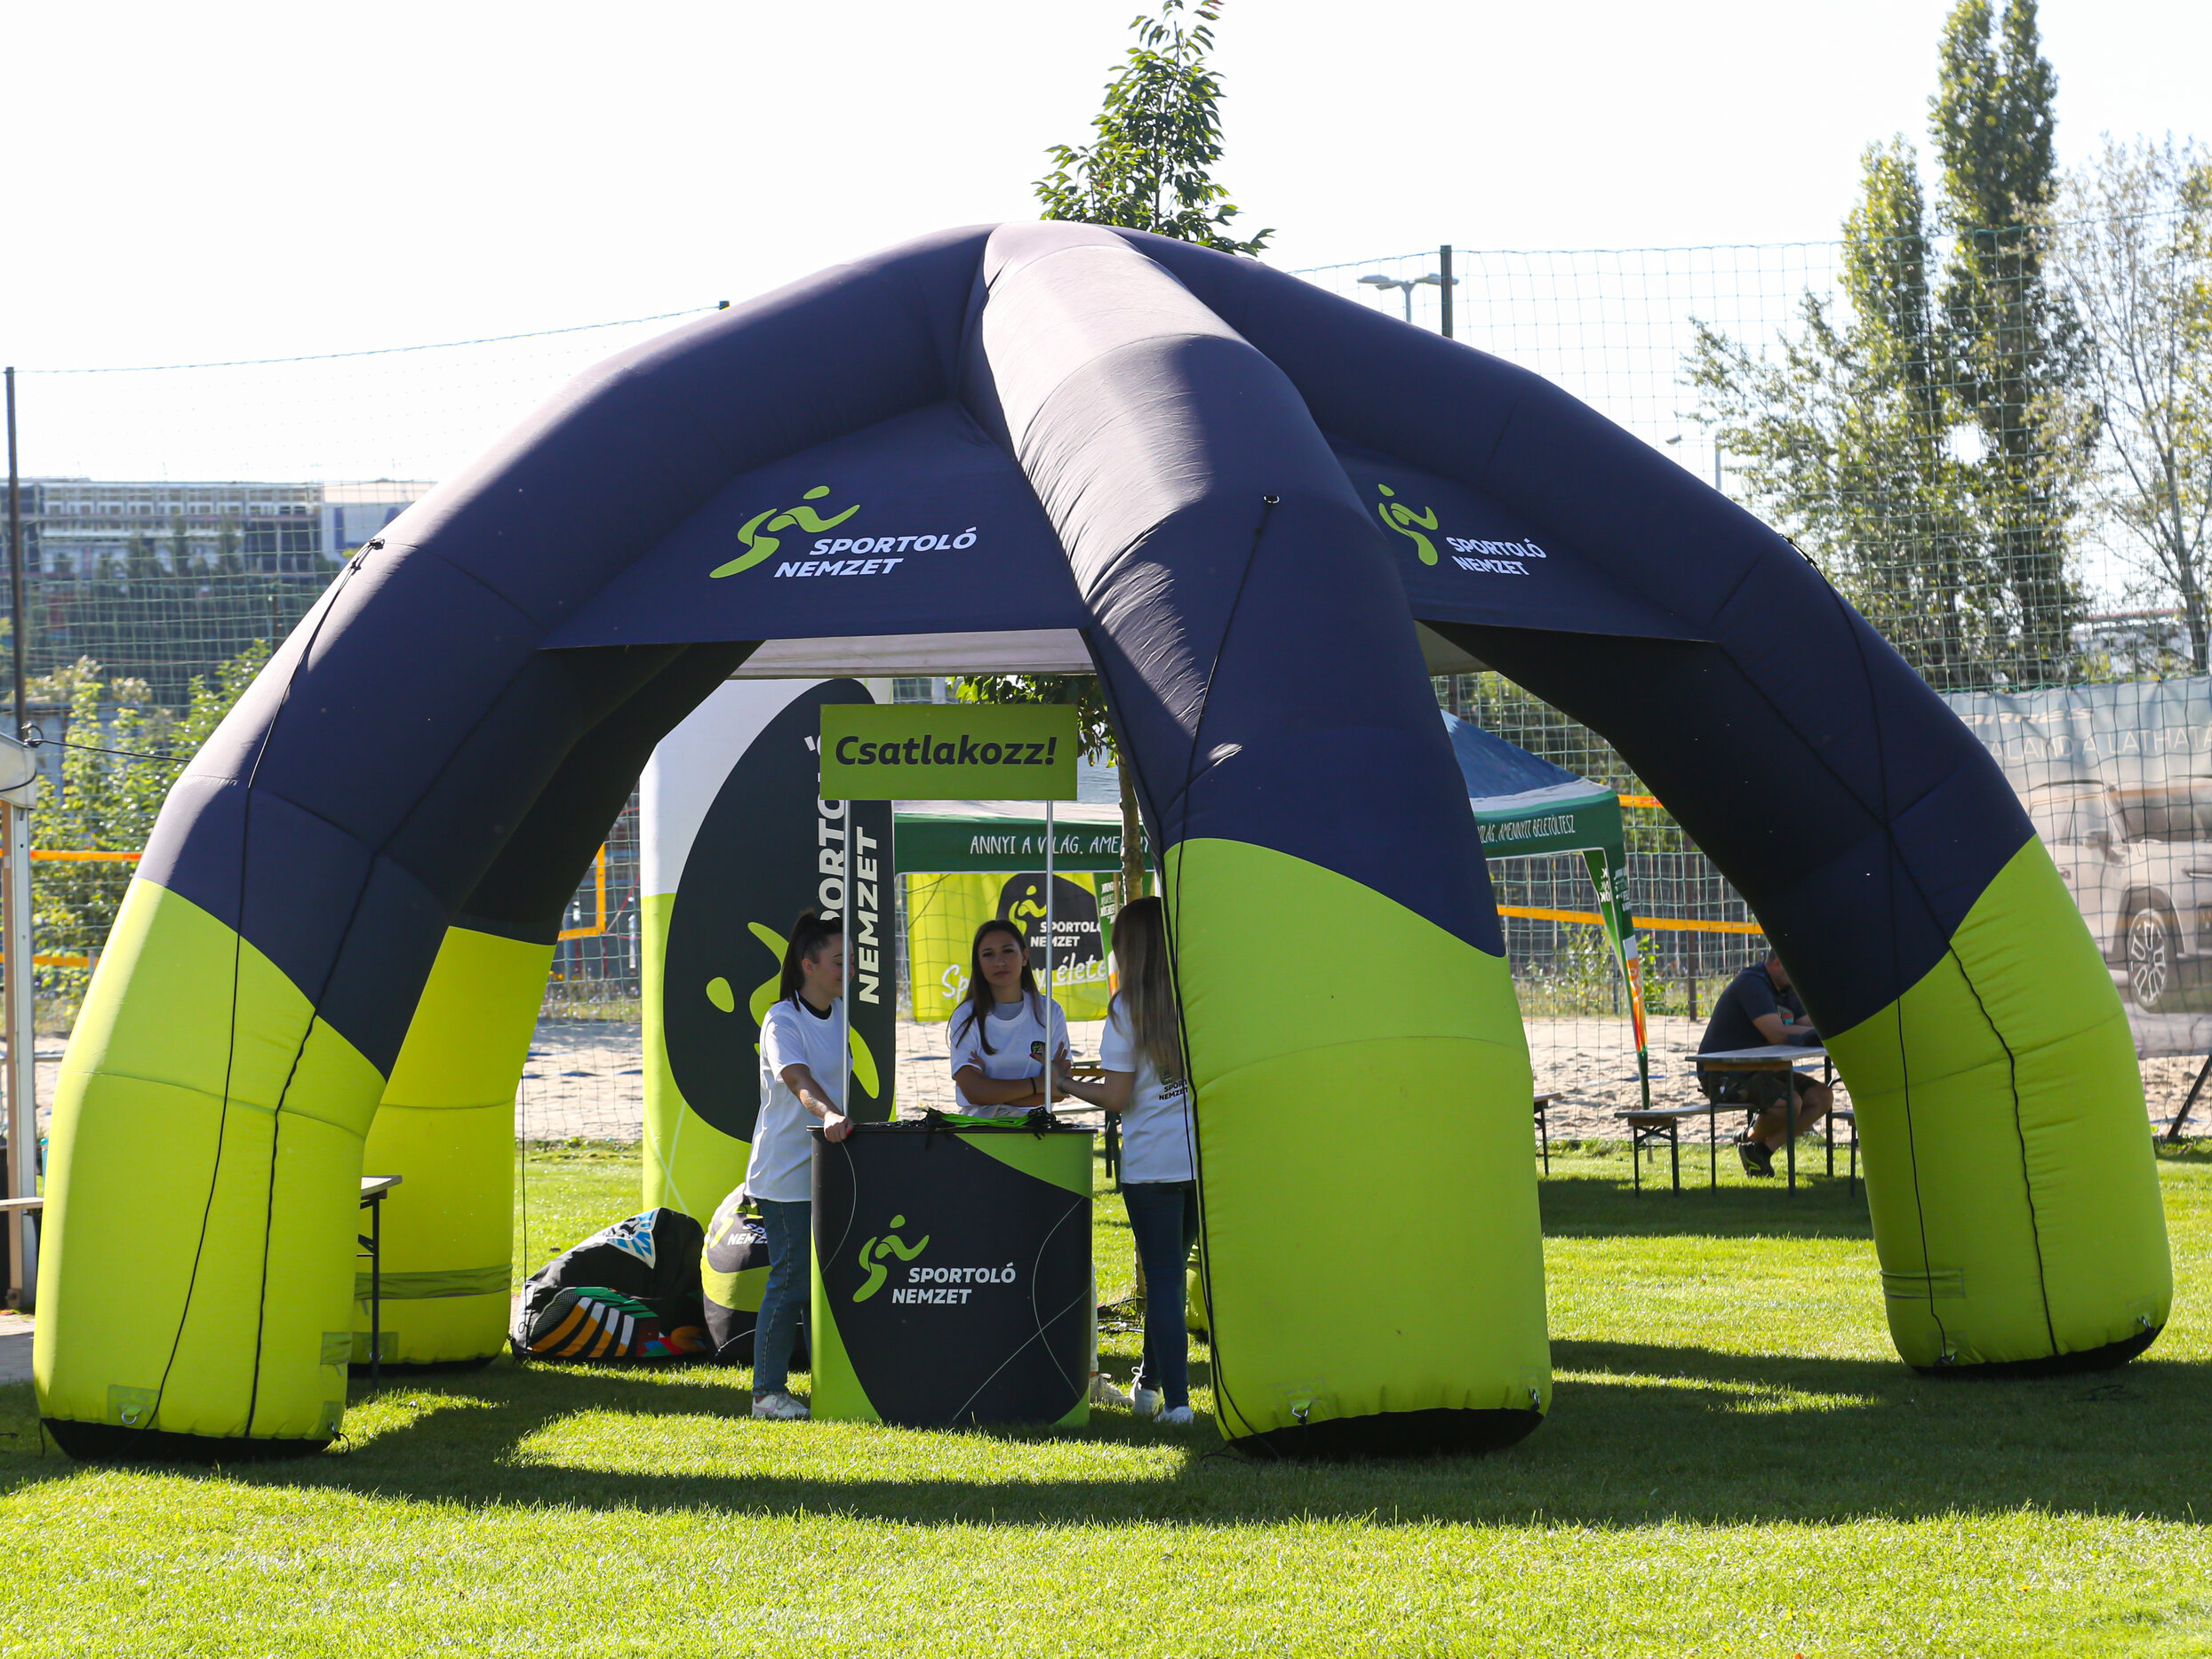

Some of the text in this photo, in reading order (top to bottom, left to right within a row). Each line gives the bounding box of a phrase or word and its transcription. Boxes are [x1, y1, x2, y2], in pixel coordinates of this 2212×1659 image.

[809, 526, 978, 556] SPORTOLÓ
[1445, 537, 1547, 559] SPORTOLÓ
[773, 557, 905, 578] NEMZET
[1451, 555, 1530, 576] NEMZET
[834, 734, 1058, 765] Csatlakozz!
[1981, 735, 2075, 761] ALAND
[970, 835, 1016, 855] ANNYI
[1022, 836, 1032, 854] A
[856, 826, 880, 1005] NEMZET
[1056, 952, 1106, 983] élete
[1164, 1080, 1187, 1093] SPORT
[727, 1232, 768, 1246] NEMZ
[907, 1262, 1017, 1283] SPORTOLÓ
[891, 1288, 972, 1304] NEMZET
